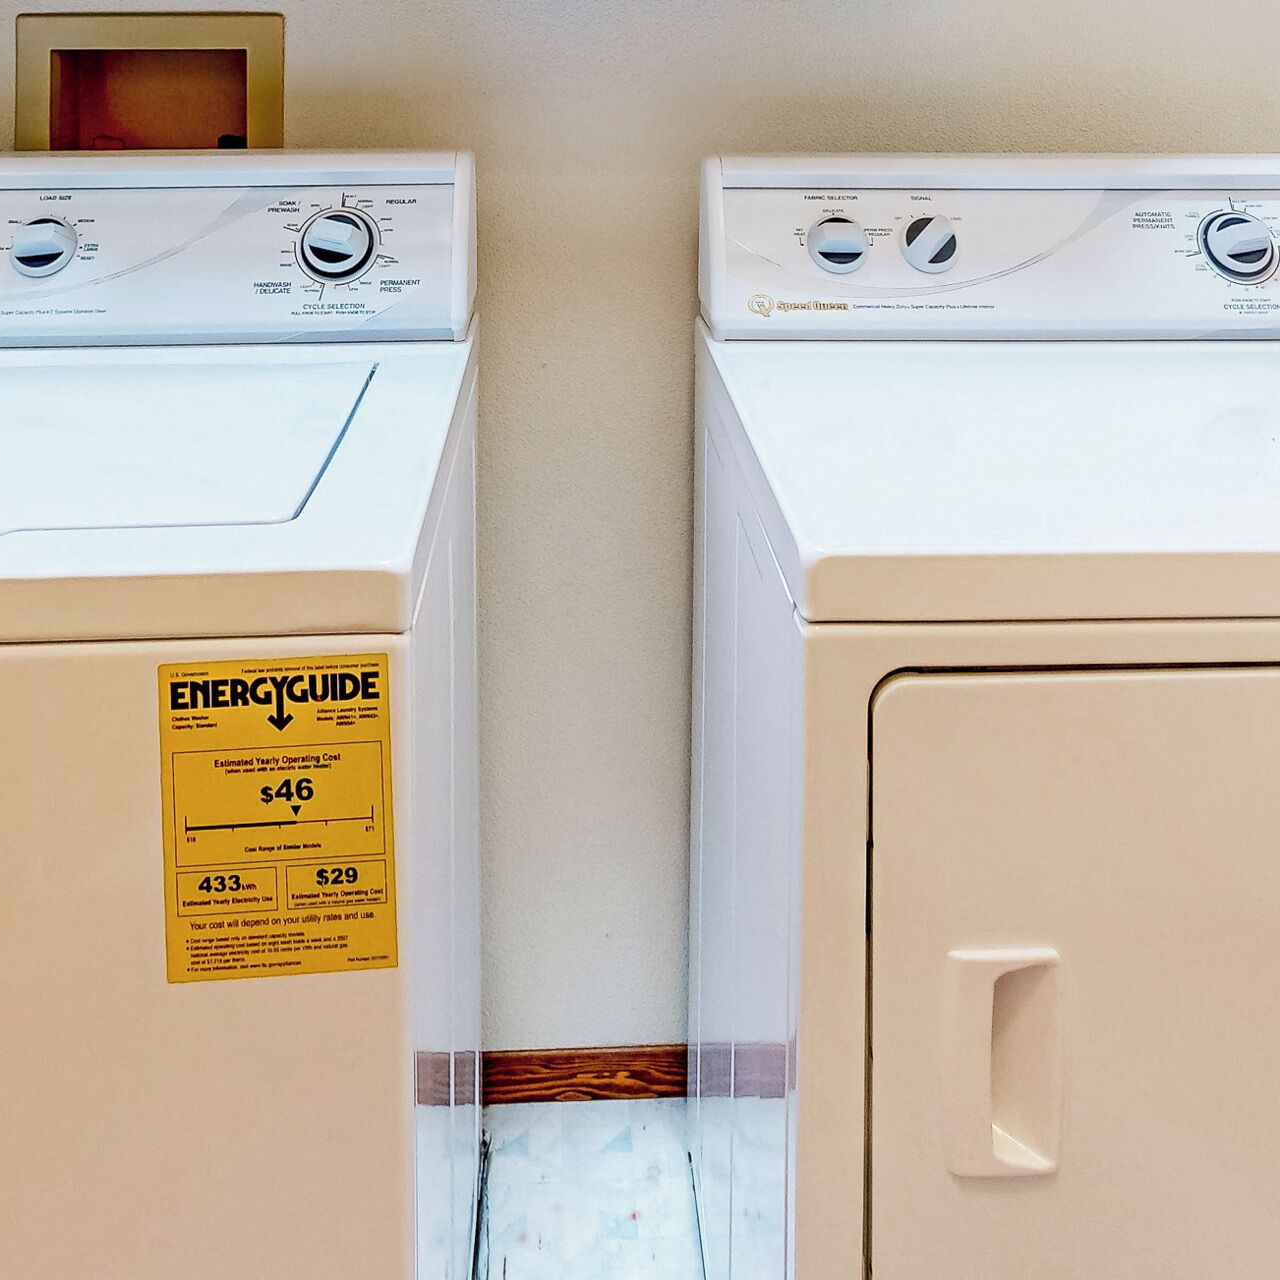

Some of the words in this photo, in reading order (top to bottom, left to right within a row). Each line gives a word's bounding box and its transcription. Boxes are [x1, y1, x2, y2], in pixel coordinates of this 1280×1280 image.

[777, 301, 811, 312] Speed
[813, 301, 848, 310] Queen
[170, 671, 380, 711] ENERGYGUIDE
[214, 759, 253, 768] Estimated
[256, 756, 279, 766] Yearly
[282, 754, 320, 763] Operating
[322, 753, 340, 762] Cost
[260, 778, 314, 805] $46
[316, 867, 358, 887] $29
[190, 922, 206, 930] Your
[241, 918, 269, 927] depend
